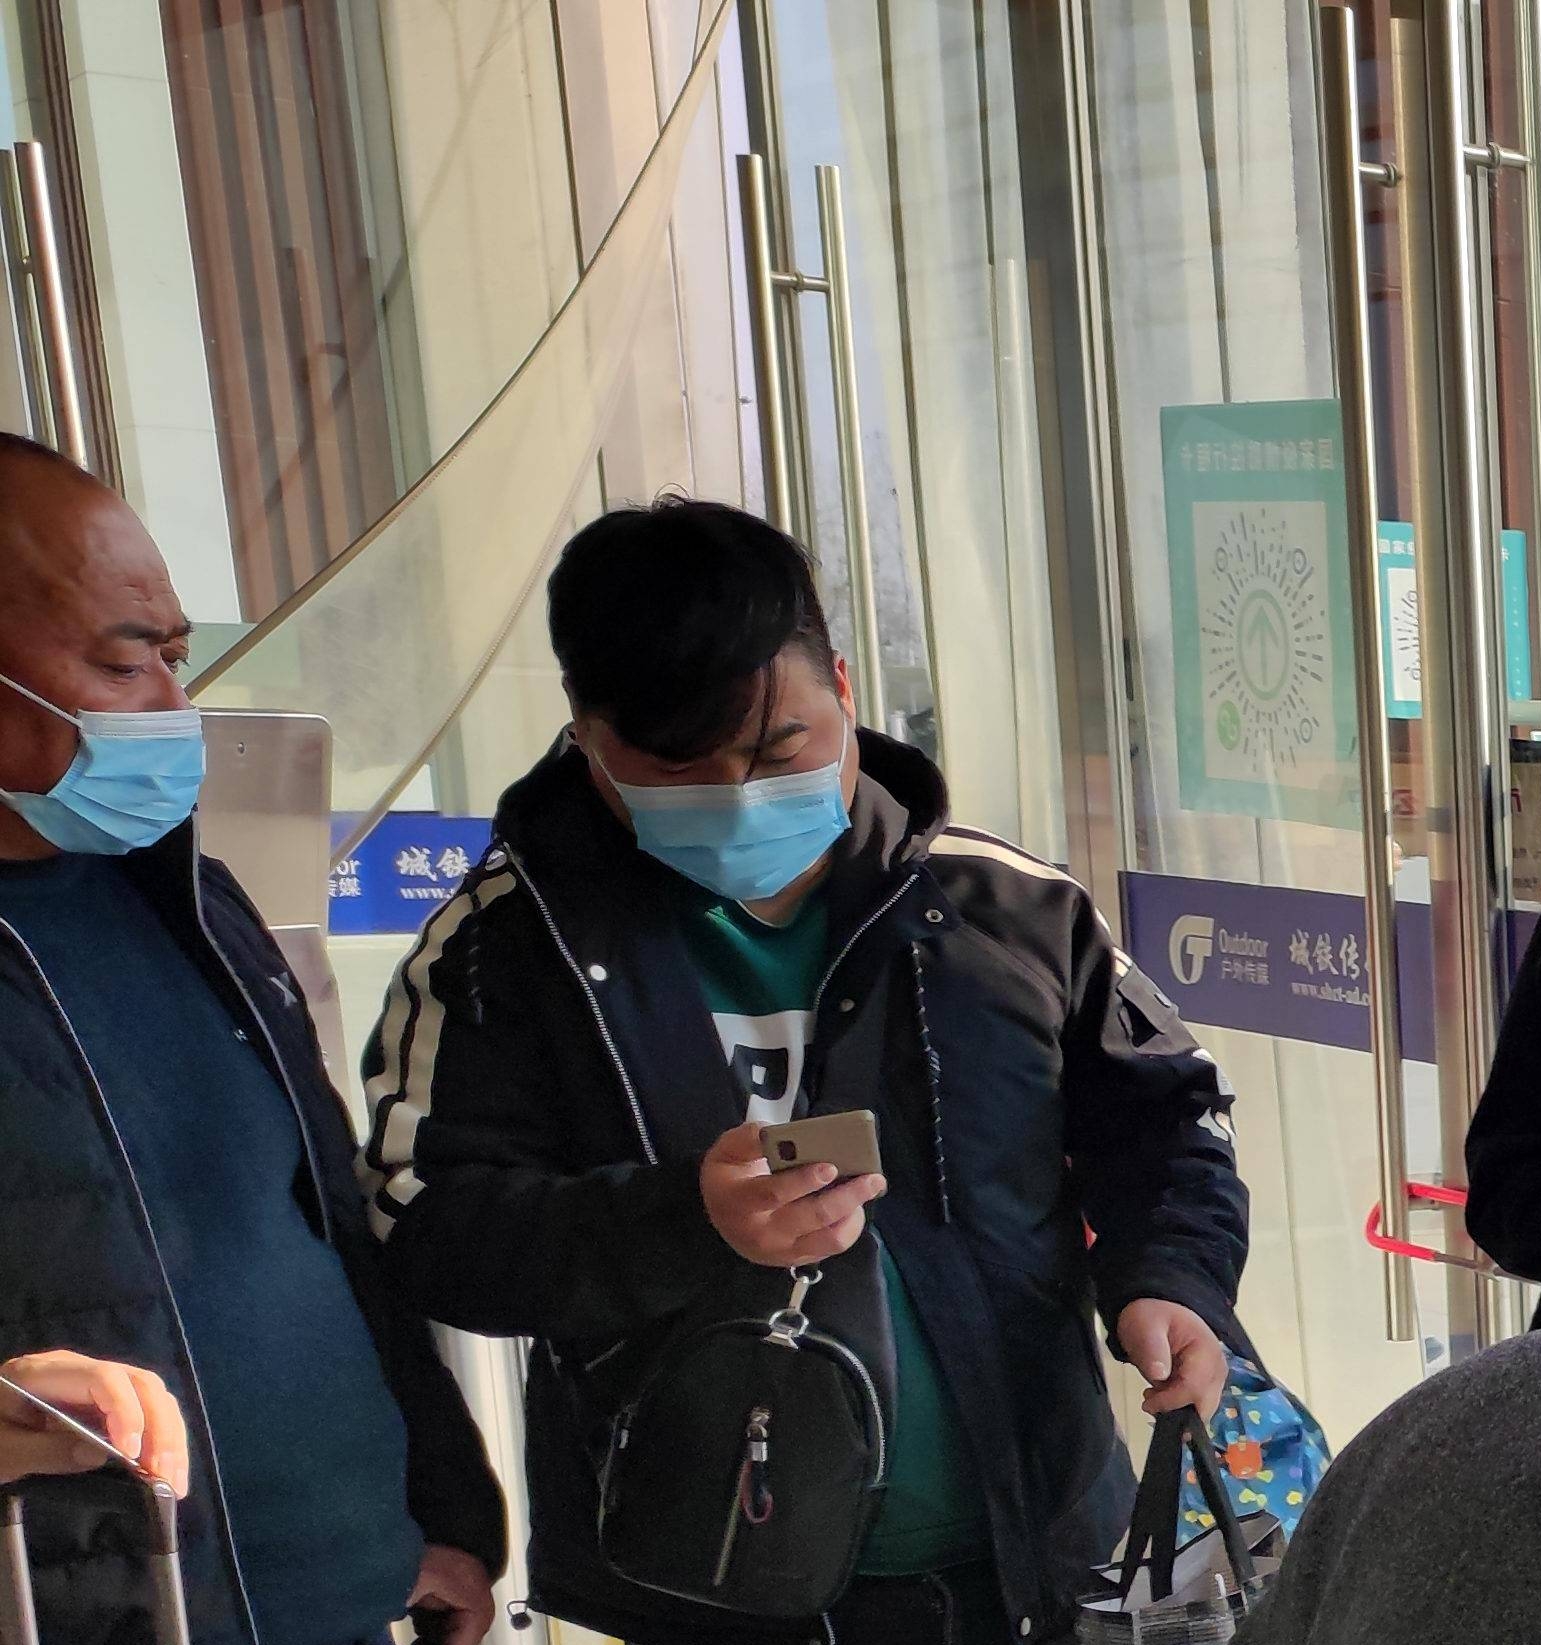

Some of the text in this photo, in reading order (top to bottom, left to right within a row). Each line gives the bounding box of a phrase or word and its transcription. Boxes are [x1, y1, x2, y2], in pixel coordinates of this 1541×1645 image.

[1218, 928, 1270, 958] Outdoor
[1288, 928, 1370, 980] 城铁传
